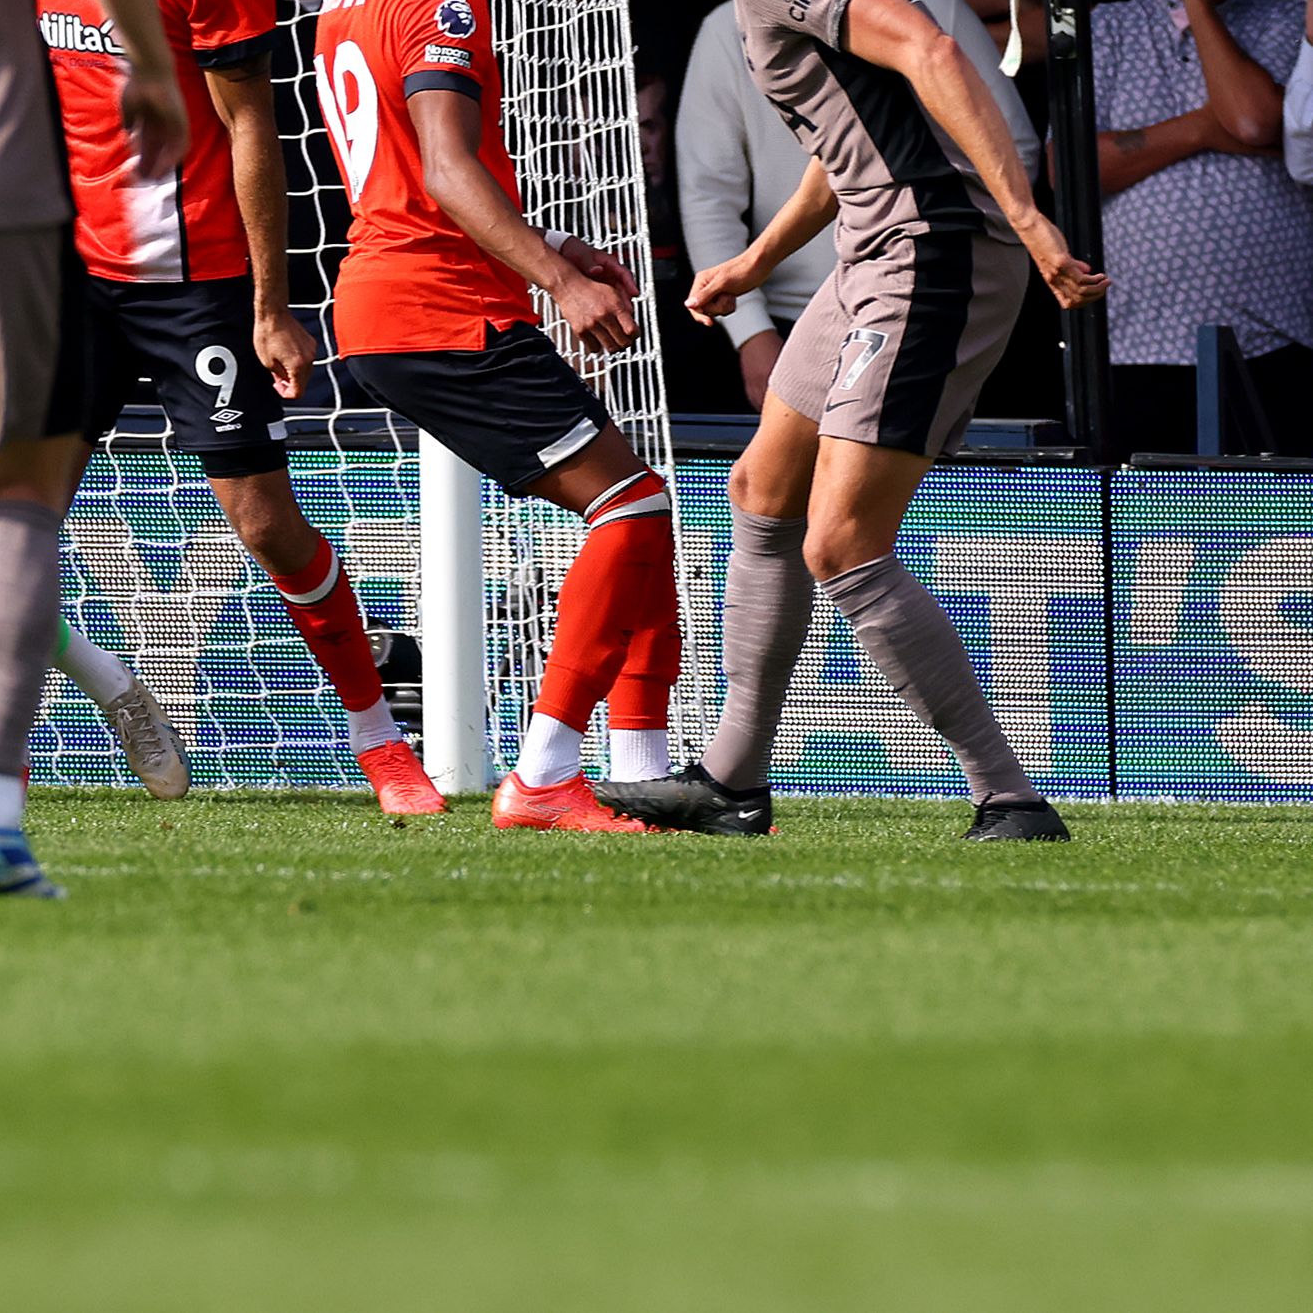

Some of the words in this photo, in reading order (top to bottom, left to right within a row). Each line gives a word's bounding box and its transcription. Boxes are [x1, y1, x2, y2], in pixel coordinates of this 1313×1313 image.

[312, 39, 379, 204] 19
[195, 344, 238, 409] 9
[830, 327, 889, 391] 7
